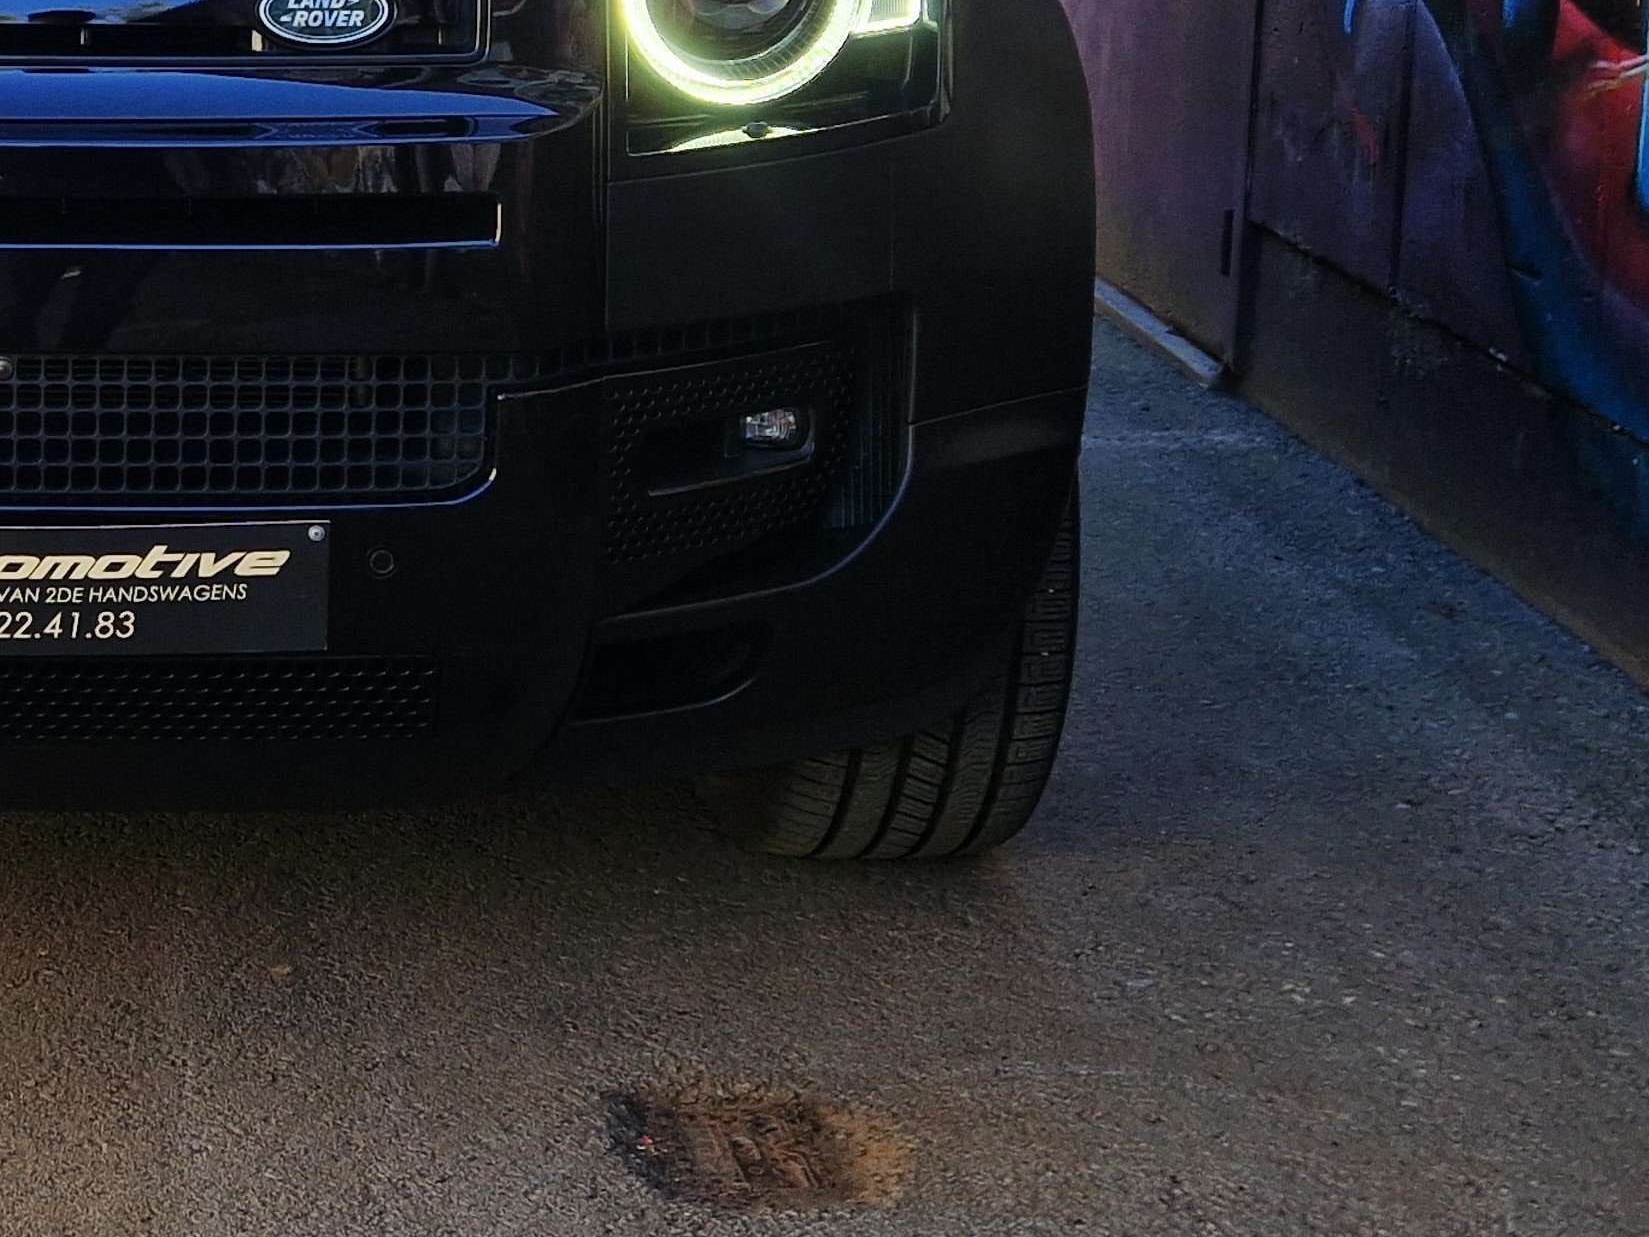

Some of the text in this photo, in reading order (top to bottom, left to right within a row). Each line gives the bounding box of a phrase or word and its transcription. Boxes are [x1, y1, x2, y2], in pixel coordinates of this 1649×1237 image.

[292, 10, 365, 27] ROVER
[45, 587, 84, 604] 2DE
[88, 583, 248, 604] HANDSWAGENS
